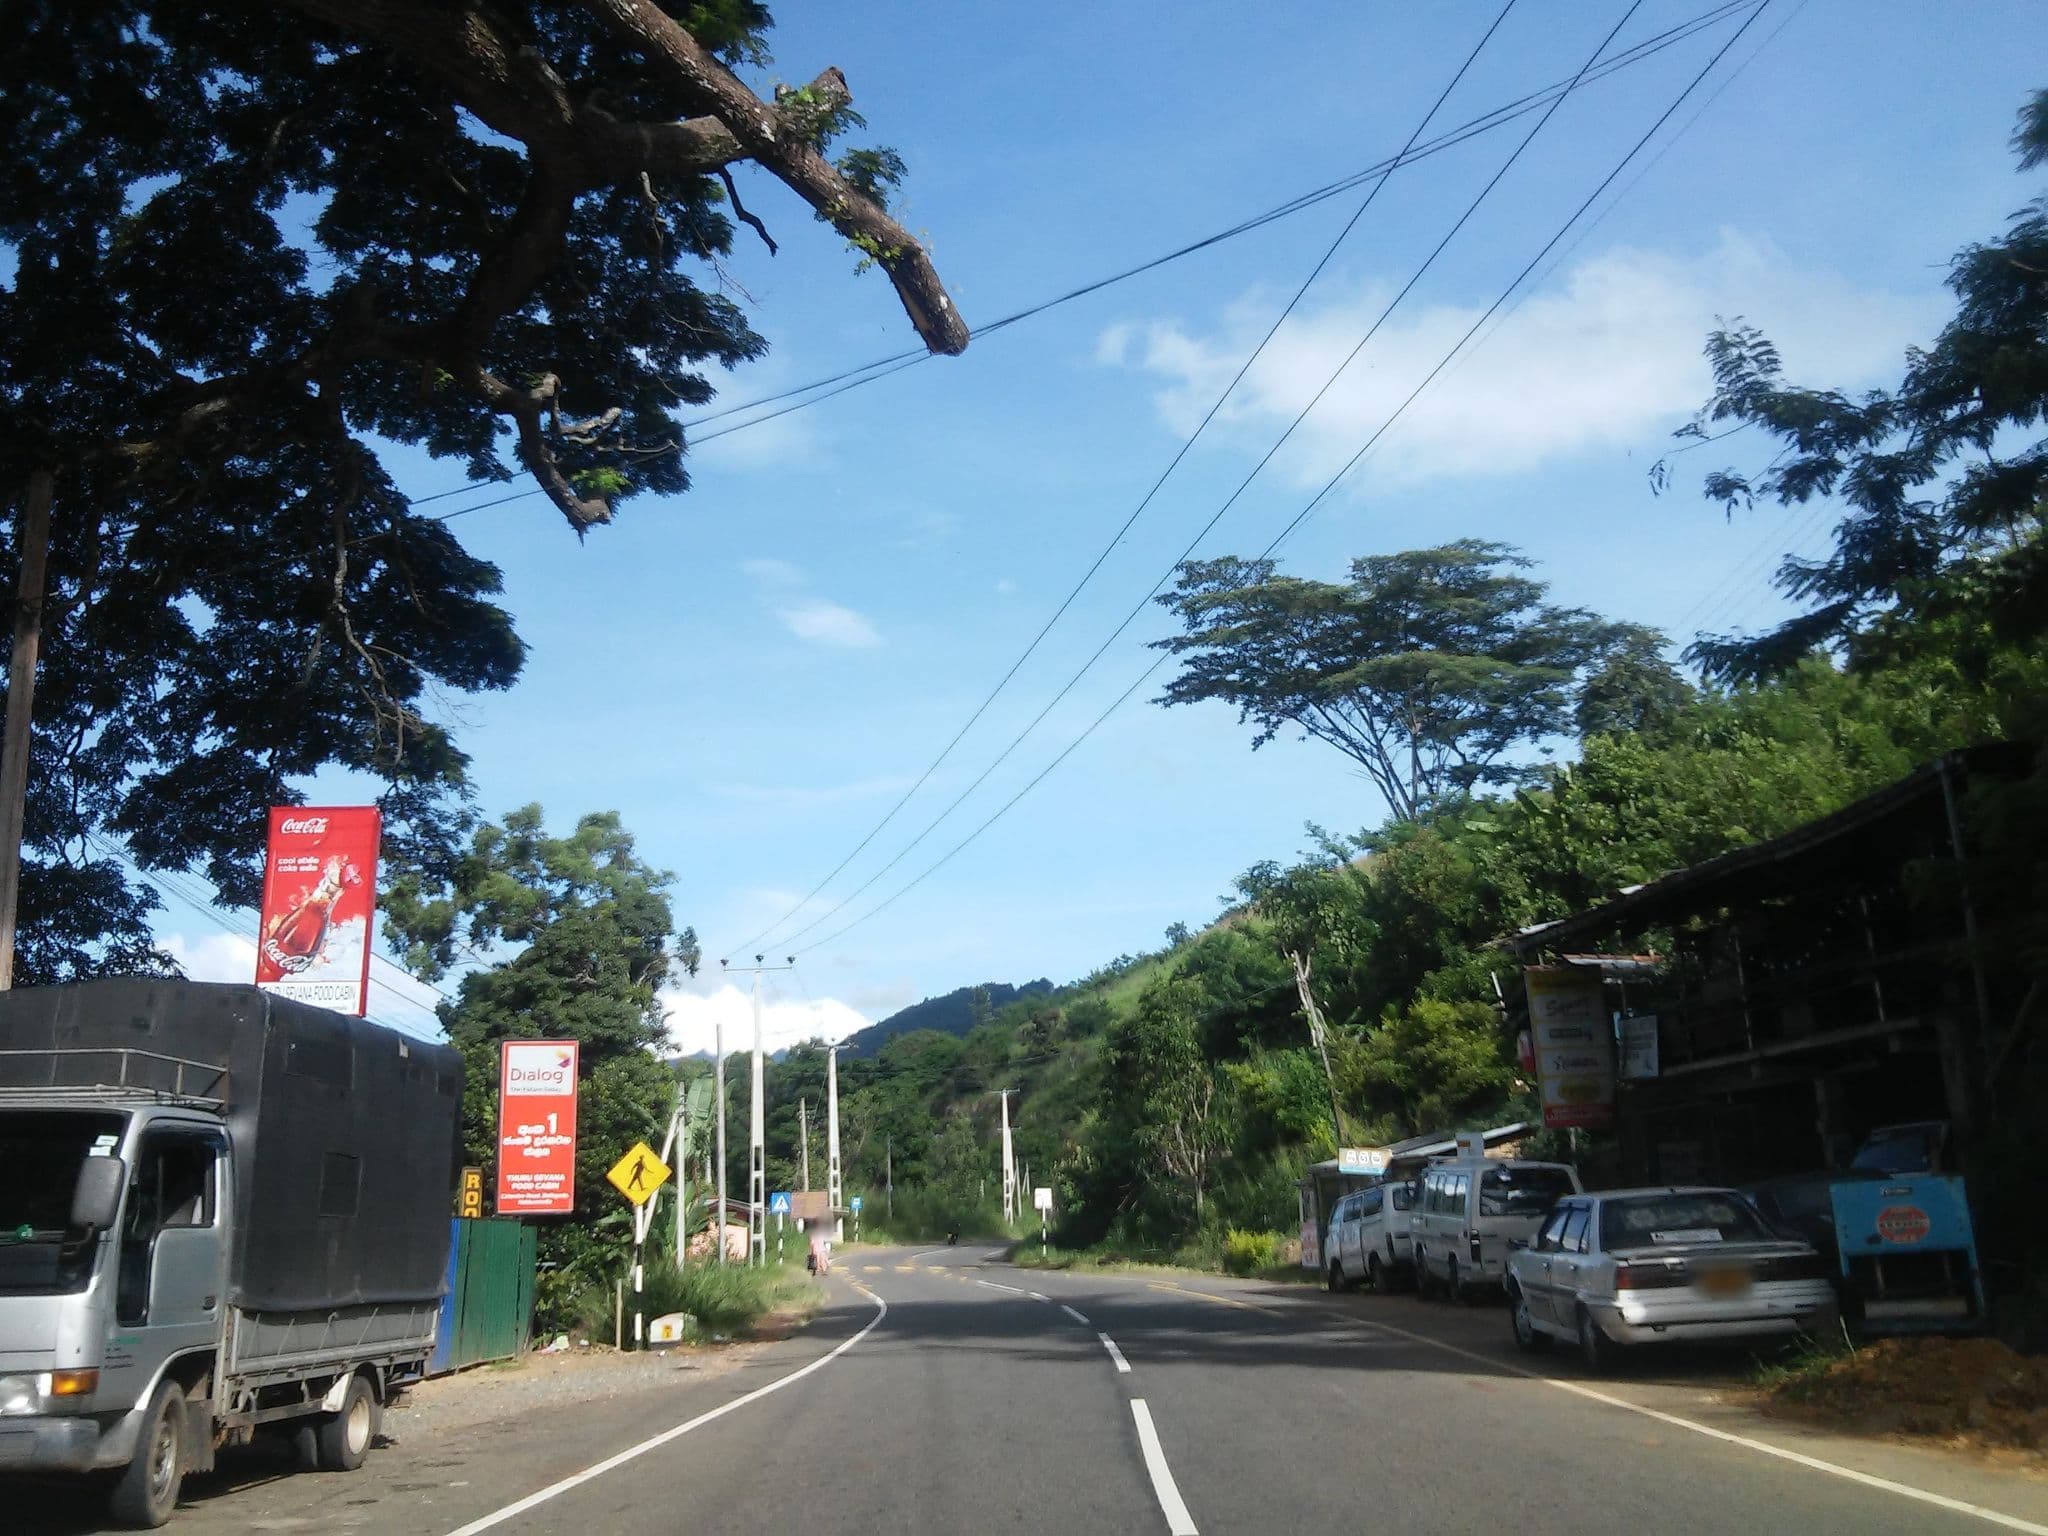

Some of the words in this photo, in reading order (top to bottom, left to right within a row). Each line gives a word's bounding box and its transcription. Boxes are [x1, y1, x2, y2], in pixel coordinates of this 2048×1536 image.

[281, 818, 329, 834] Coca-Cola
[264, 939, 314, 973] Coca-Cola
[511, 1068, 563, 1084] Dialog
[547, 1112, 558, 1135] 1
